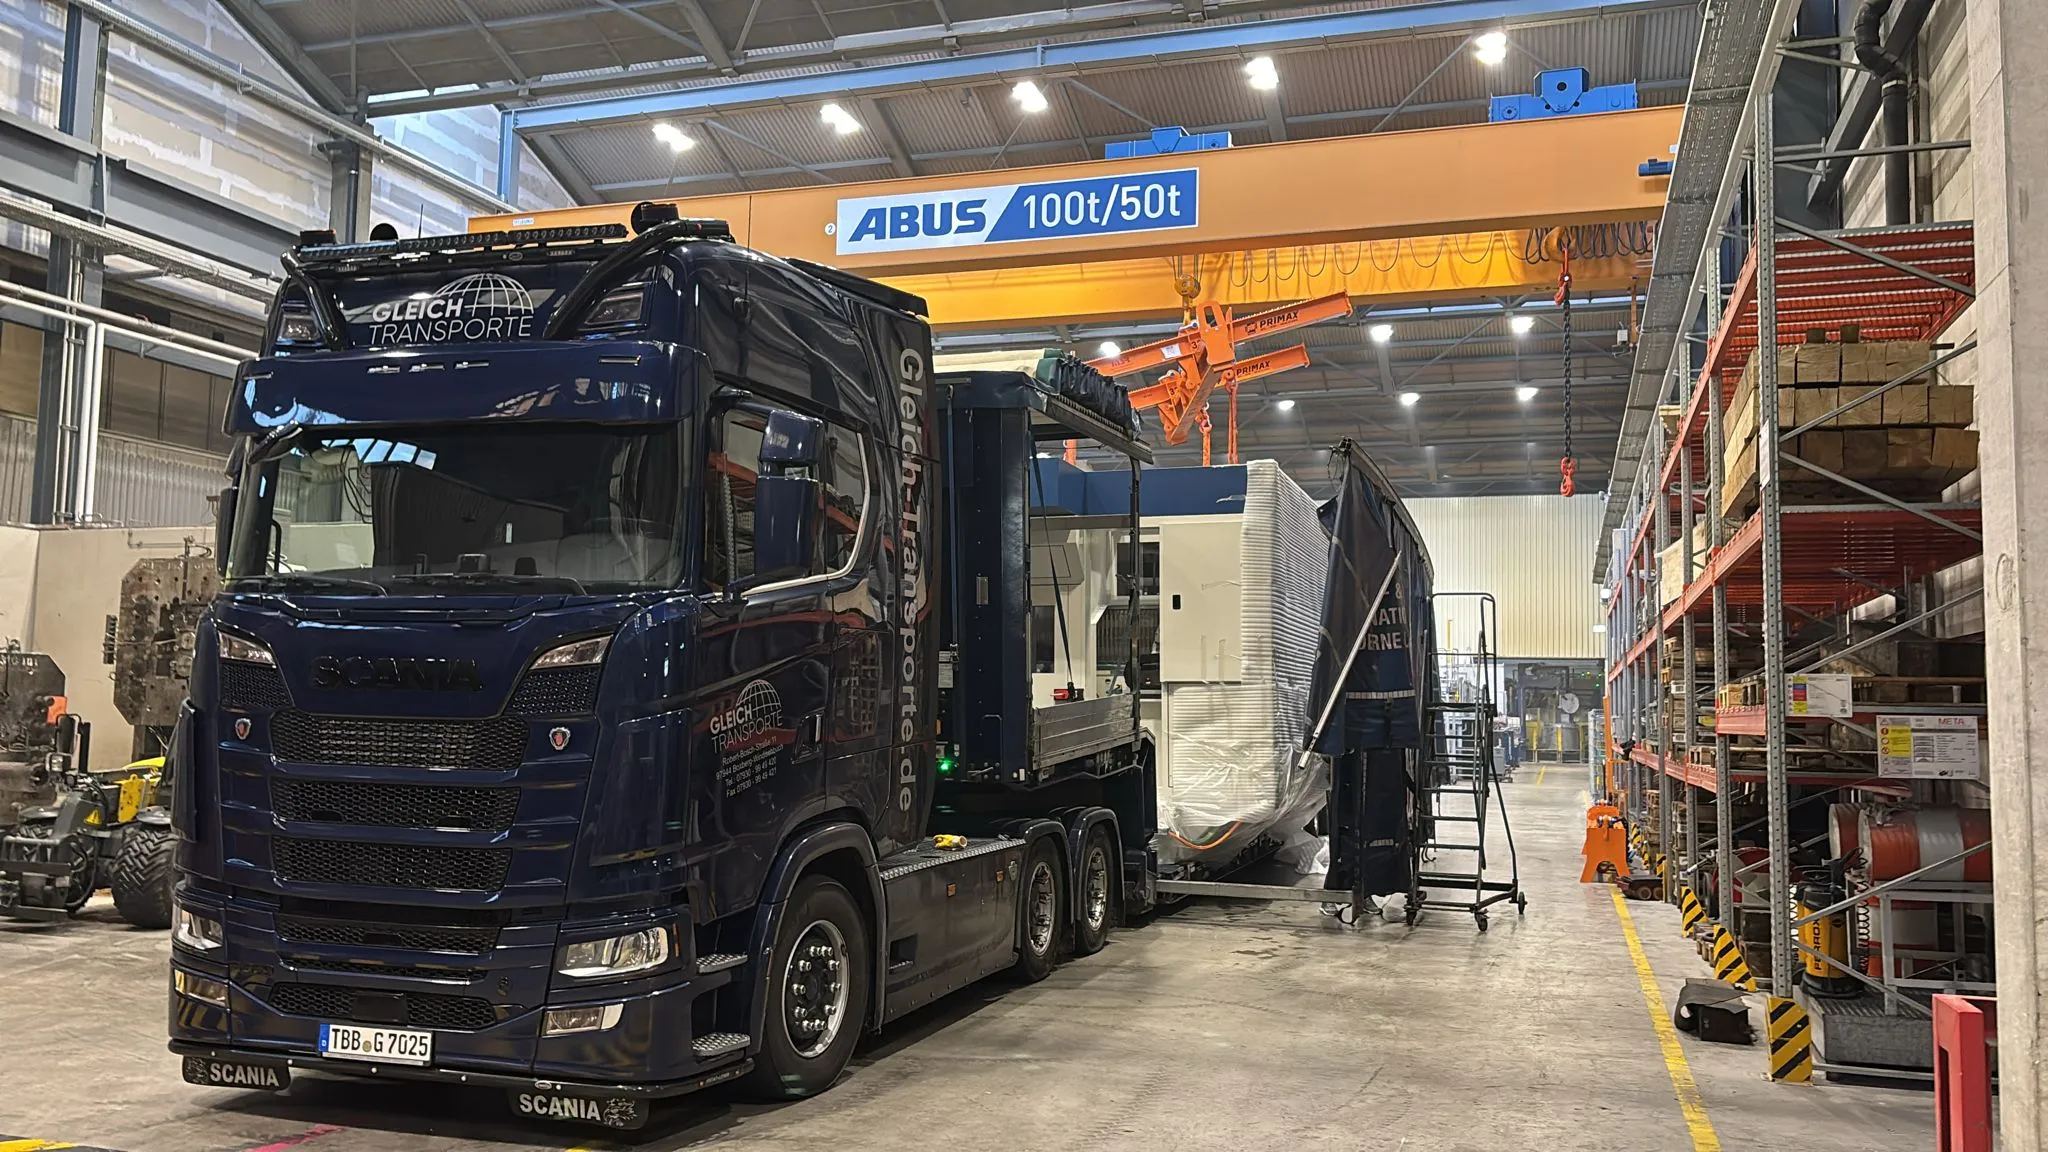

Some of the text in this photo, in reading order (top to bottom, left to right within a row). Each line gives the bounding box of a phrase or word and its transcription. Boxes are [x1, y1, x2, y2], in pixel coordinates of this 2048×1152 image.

[848, 183, 1181, 242] ABUS 100t/50t
[372, 298, 464, 323] GLEICH
[1259, 311, 1299, 329] PRIMAX
[369, 316, 534, 345] TRANSPORTE
[1235, 361, 1272, 376] PRIMAX
[899, 348, 924, 812] Gleich-Transporte.de
[311, 655, 485, 692] SCANIA
[710, 703, 753, 735] GLEICH
[711, 709, 783, 754] TRANSPORTE
[332, 1028, 428, 1056] TBB G 7025
[210, 1063, 280, 1087] SCANIA
[520, 1093, 601, 1121] SCANIA
